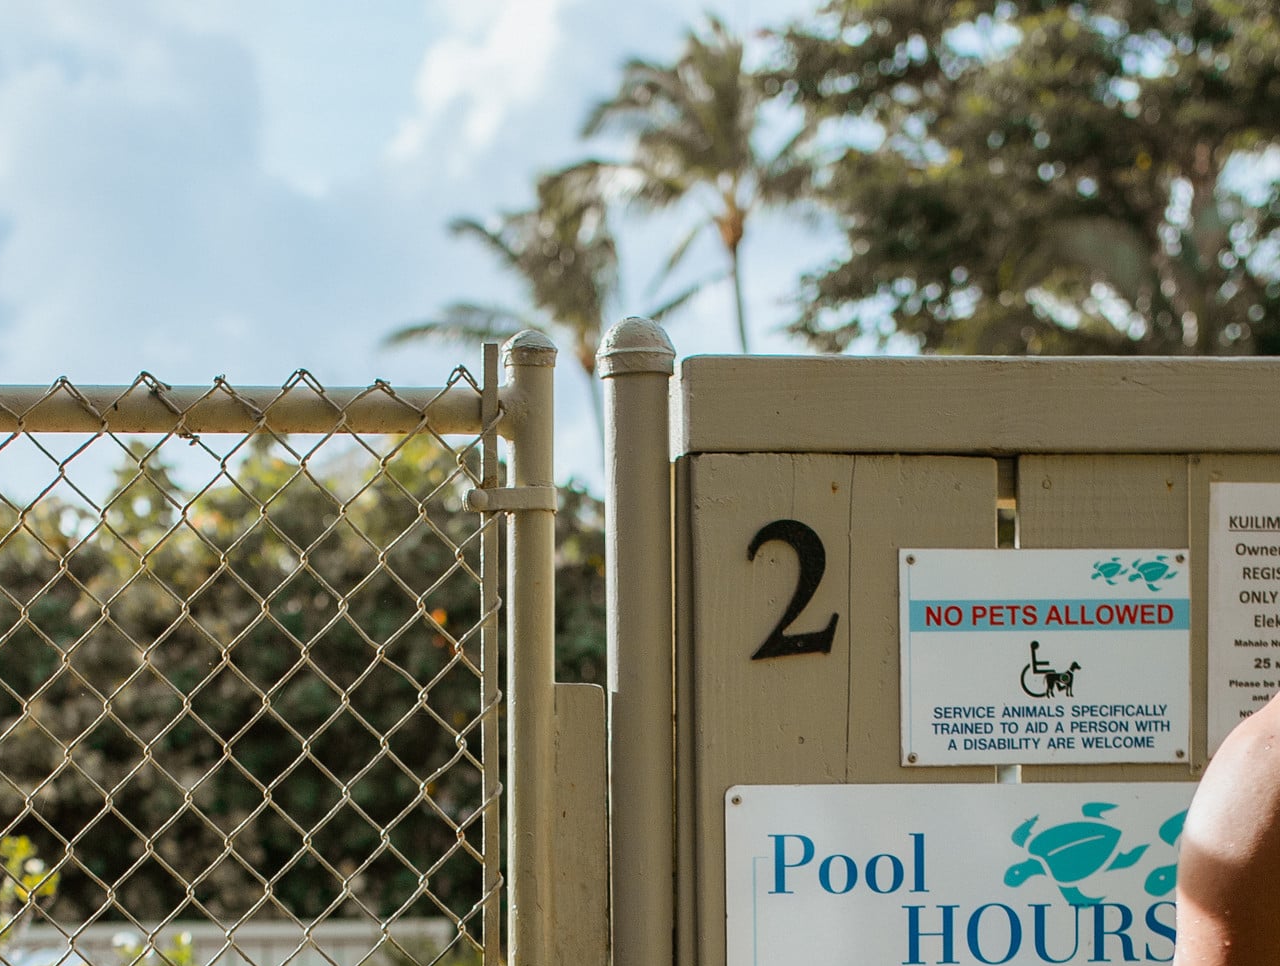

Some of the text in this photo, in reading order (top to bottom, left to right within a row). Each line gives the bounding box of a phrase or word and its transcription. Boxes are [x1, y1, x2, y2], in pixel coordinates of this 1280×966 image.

[746, 519, 840, 661] 2
[1238, 590, 1279, 605] ONLY
[926, 603, 1175, 628] NO PETS ALLOWED
[1234, 638, 1269, 648] Mahalo
[1254, 657, 1272, 670] 25
[1228, 679, 1261, 689] Please
[933, 703, 1169, 720] SERVICE ANIMALS SPECIFICALLY
[932, 719, 1171, 736] TRAINED TO AID A PERSON WITH
[947, 735, 1156, 751] A DISABILITY ARE WELCOME
[767, 832, 930, 895] Pool
[901, 901, 1177, 966] HOURS
